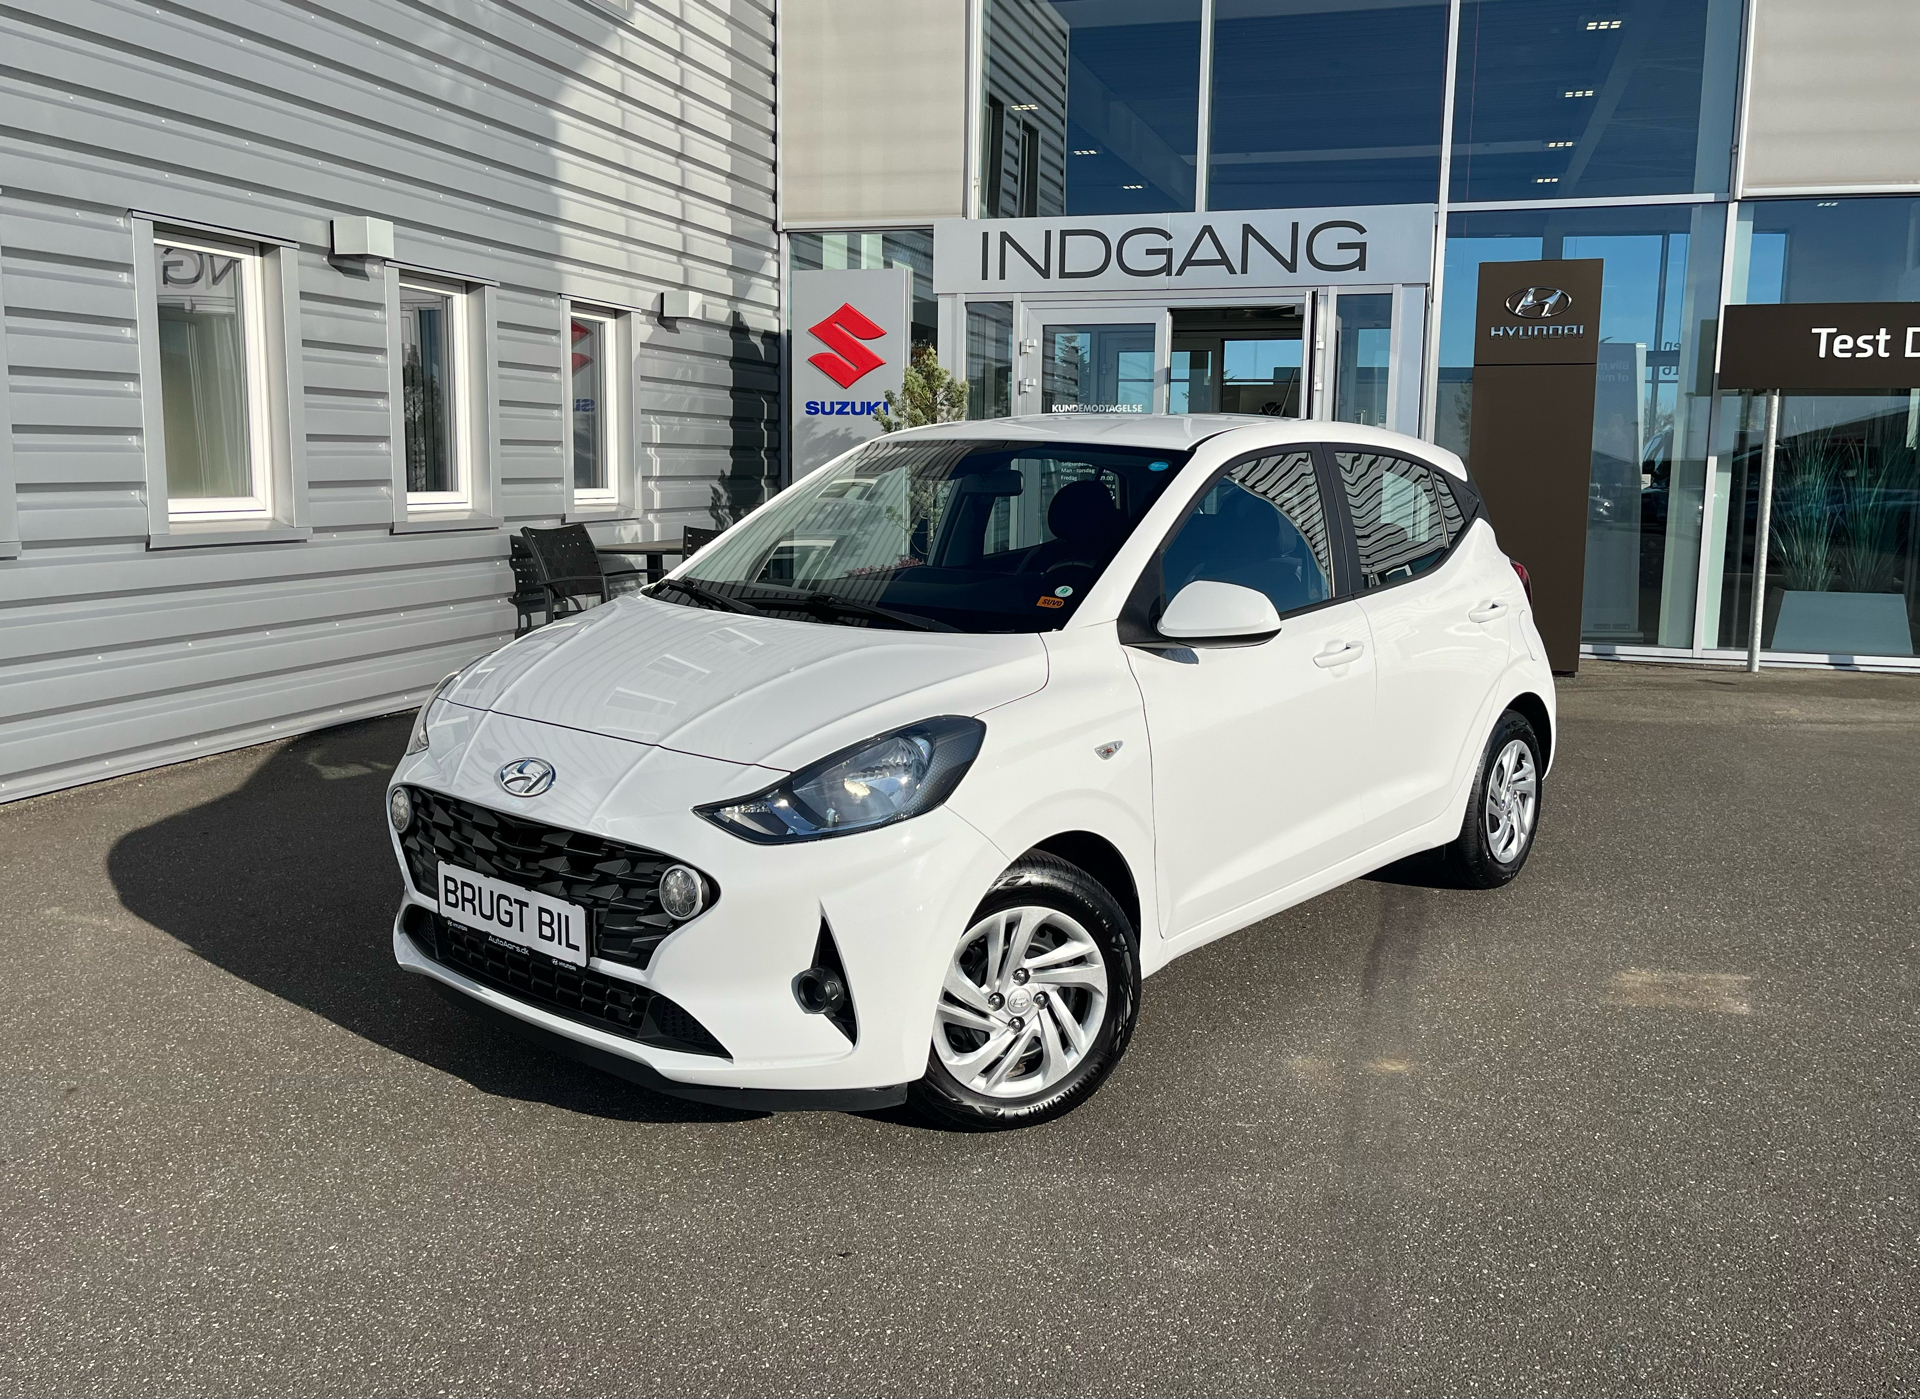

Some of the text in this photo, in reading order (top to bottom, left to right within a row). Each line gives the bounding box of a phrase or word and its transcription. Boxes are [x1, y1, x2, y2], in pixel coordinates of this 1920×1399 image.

[981, 220, 1368, 281] INDGANG
[1490, 324, 1584, 339] HYUNDAI
[1811, 327, 1892, 358] Test
[805, 401, 889, 416] SUZUKI
[1052, 404, 1143, 413] KUNDEMODTAGELSE
[443, 874, 581, 953] BRUGT BIL
